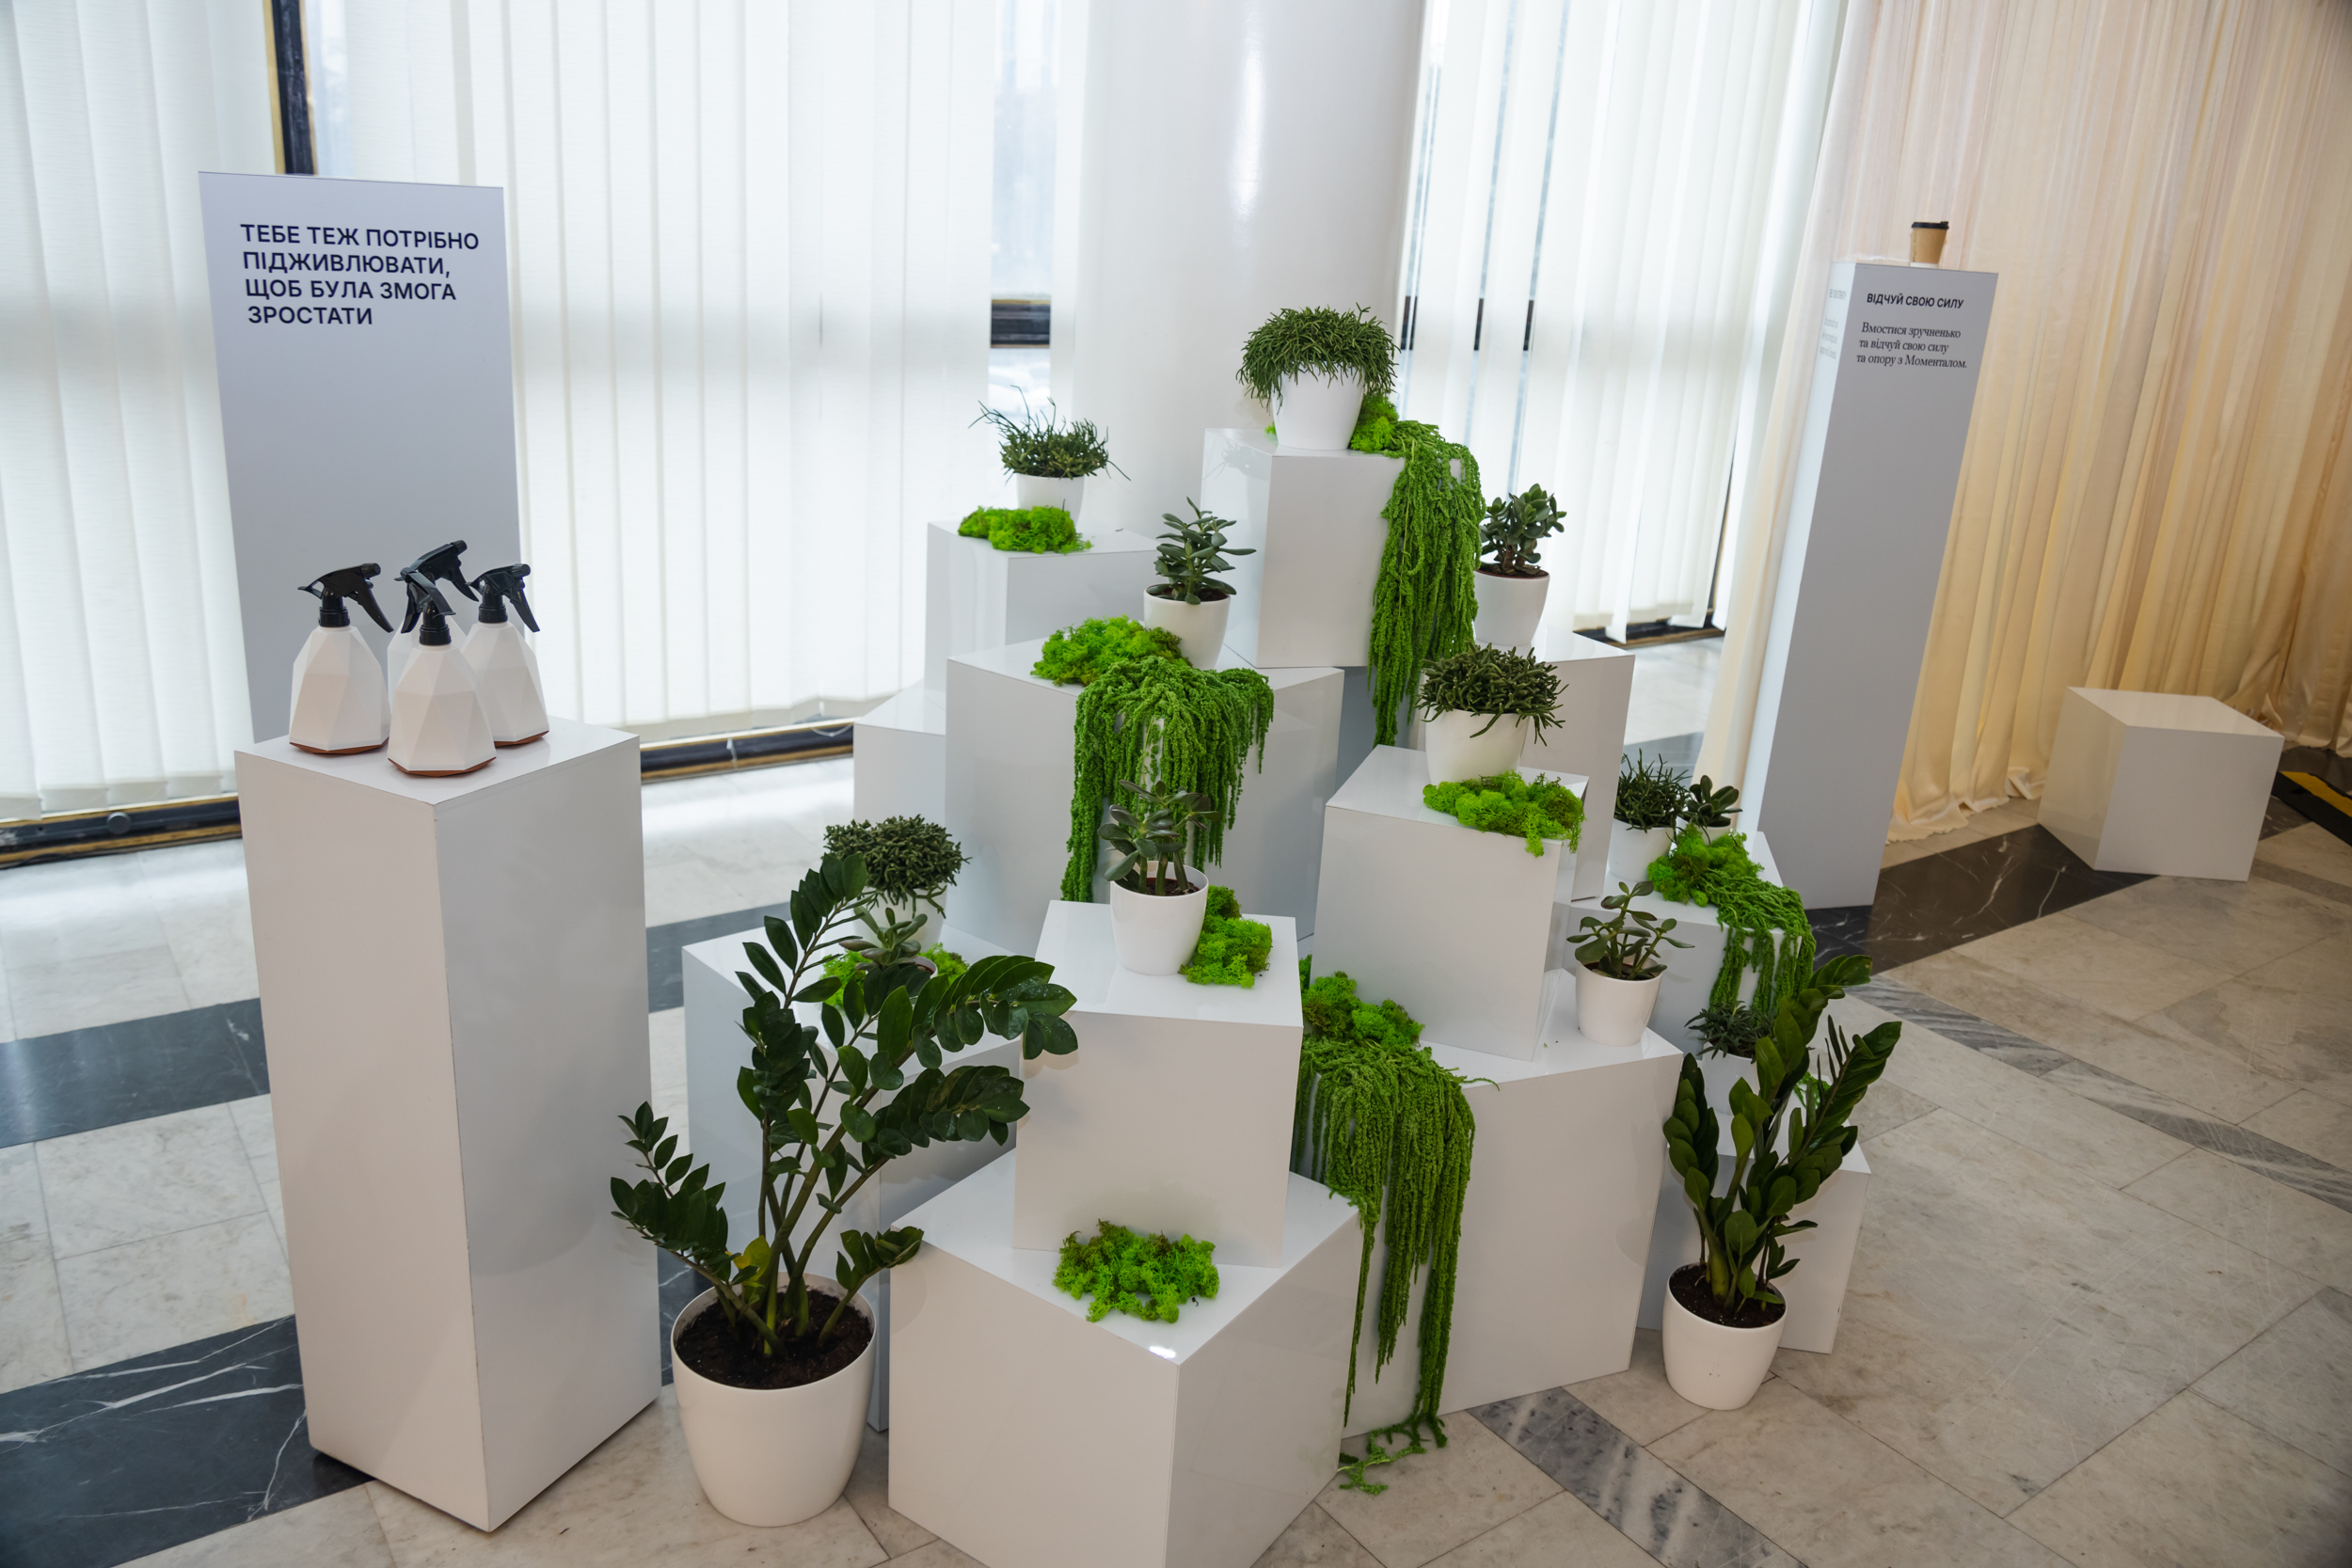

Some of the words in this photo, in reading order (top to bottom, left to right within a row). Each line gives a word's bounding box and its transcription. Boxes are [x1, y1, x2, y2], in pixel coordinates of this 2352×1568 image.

[241, 224, 300, 243] ТЕБЕ
[307, 227, 359, 245] ТЕЖ
[367, 230, 478, 249] ПОТРІБНО
[244, 252, 449, 277] ПІДЖИВЛЮВАТИ,
[246, 279, 302, 300] ЩОБ
[311, 280, 373, 298] БУЛА
[381, 282, 456, 300] ЗМОГА
[1867, 293, 1903, 305] ВІДЧУЙ
[1906, 296, 1934, 307] СВОЮ
[1937, 297, 1963, 309] СИЛУ
[248, 306, 372, 325] ЗРОСТАТИ
[1861, 322, 1908, 335] Вмостися
[1908, 328, 1962, 338] зручненько
[1859, 340, 1869, 348] та
[1870, 339, 1901, 352] відчуй
[1927, 344, 1949, 355] силу
[1856, 355, 1867, 363] та
[1867, 356, 1897, 367] опору
[1897, 356, 1903, 365] з
[1904, 355, 1967, 368] Моменталом.
